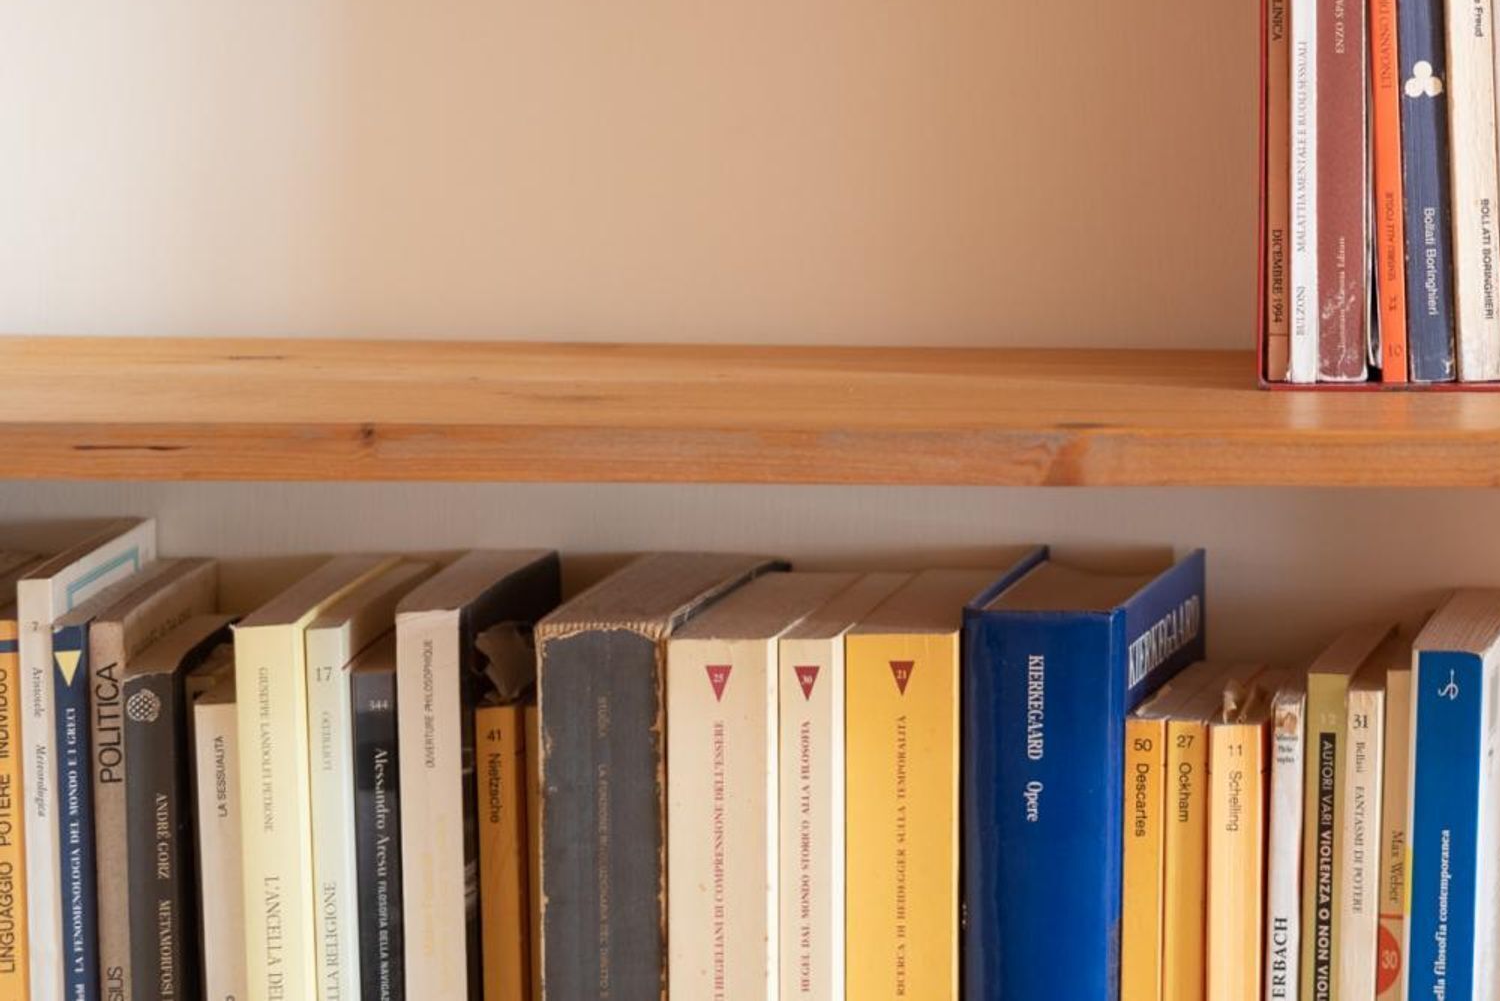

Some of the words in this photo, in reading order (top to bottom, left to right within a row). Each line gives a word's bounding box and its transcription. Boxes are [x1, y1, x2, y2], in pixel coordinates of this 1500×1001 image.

[1424, 208, 1436, 245] Bollati
[1272, 229, 1283, 294] DICEMBRE
[1425, 250, 1439, 315] Boringhieri
[1272, 298, 1283, 323] 1994
[316, 667, 332, 681] 17
[95, 664, 122, 784] POLITICA
[1027, 655, 1044, 759] KIERKEGAARD
[1135, 739, 1152, 751] 50
[1177, 736, 1193, 748] 27
[1320, 740, 1333, 790] AUTORI
[373, 748, 391, 829] Alessandro
[489, 753, 502, 823] Nietzsche
[1025, 782, 1043, 822] Opere
[1134, 763, 1149, 837] Descartes
[1178, 762, 1191, 822] Ockham
[1226, 770, 1243, 832] Schelling
[1319, 796, 1333, 825] VARI
[156, 794, 170, 839] ANDRÉ
[1353, 786, 1365, 846] FANTASMI
[157, 843, 171, 878] GORZ
[375, 835, 392, 876] Aresu
[1353, 850, 1364, 863] DI
[1390, 830, 1404, 857] Max
[1318, 830, 1332, 903] VIOLENZA
[1389, 862, 1403, 903] Weber
[1352, 867, 1364, 913] POTERE
[1318, 909, 1331, 920] O
[158, 901, 174, 995] METAMORFOSI
[1318, 926, 1331, 960] NON
